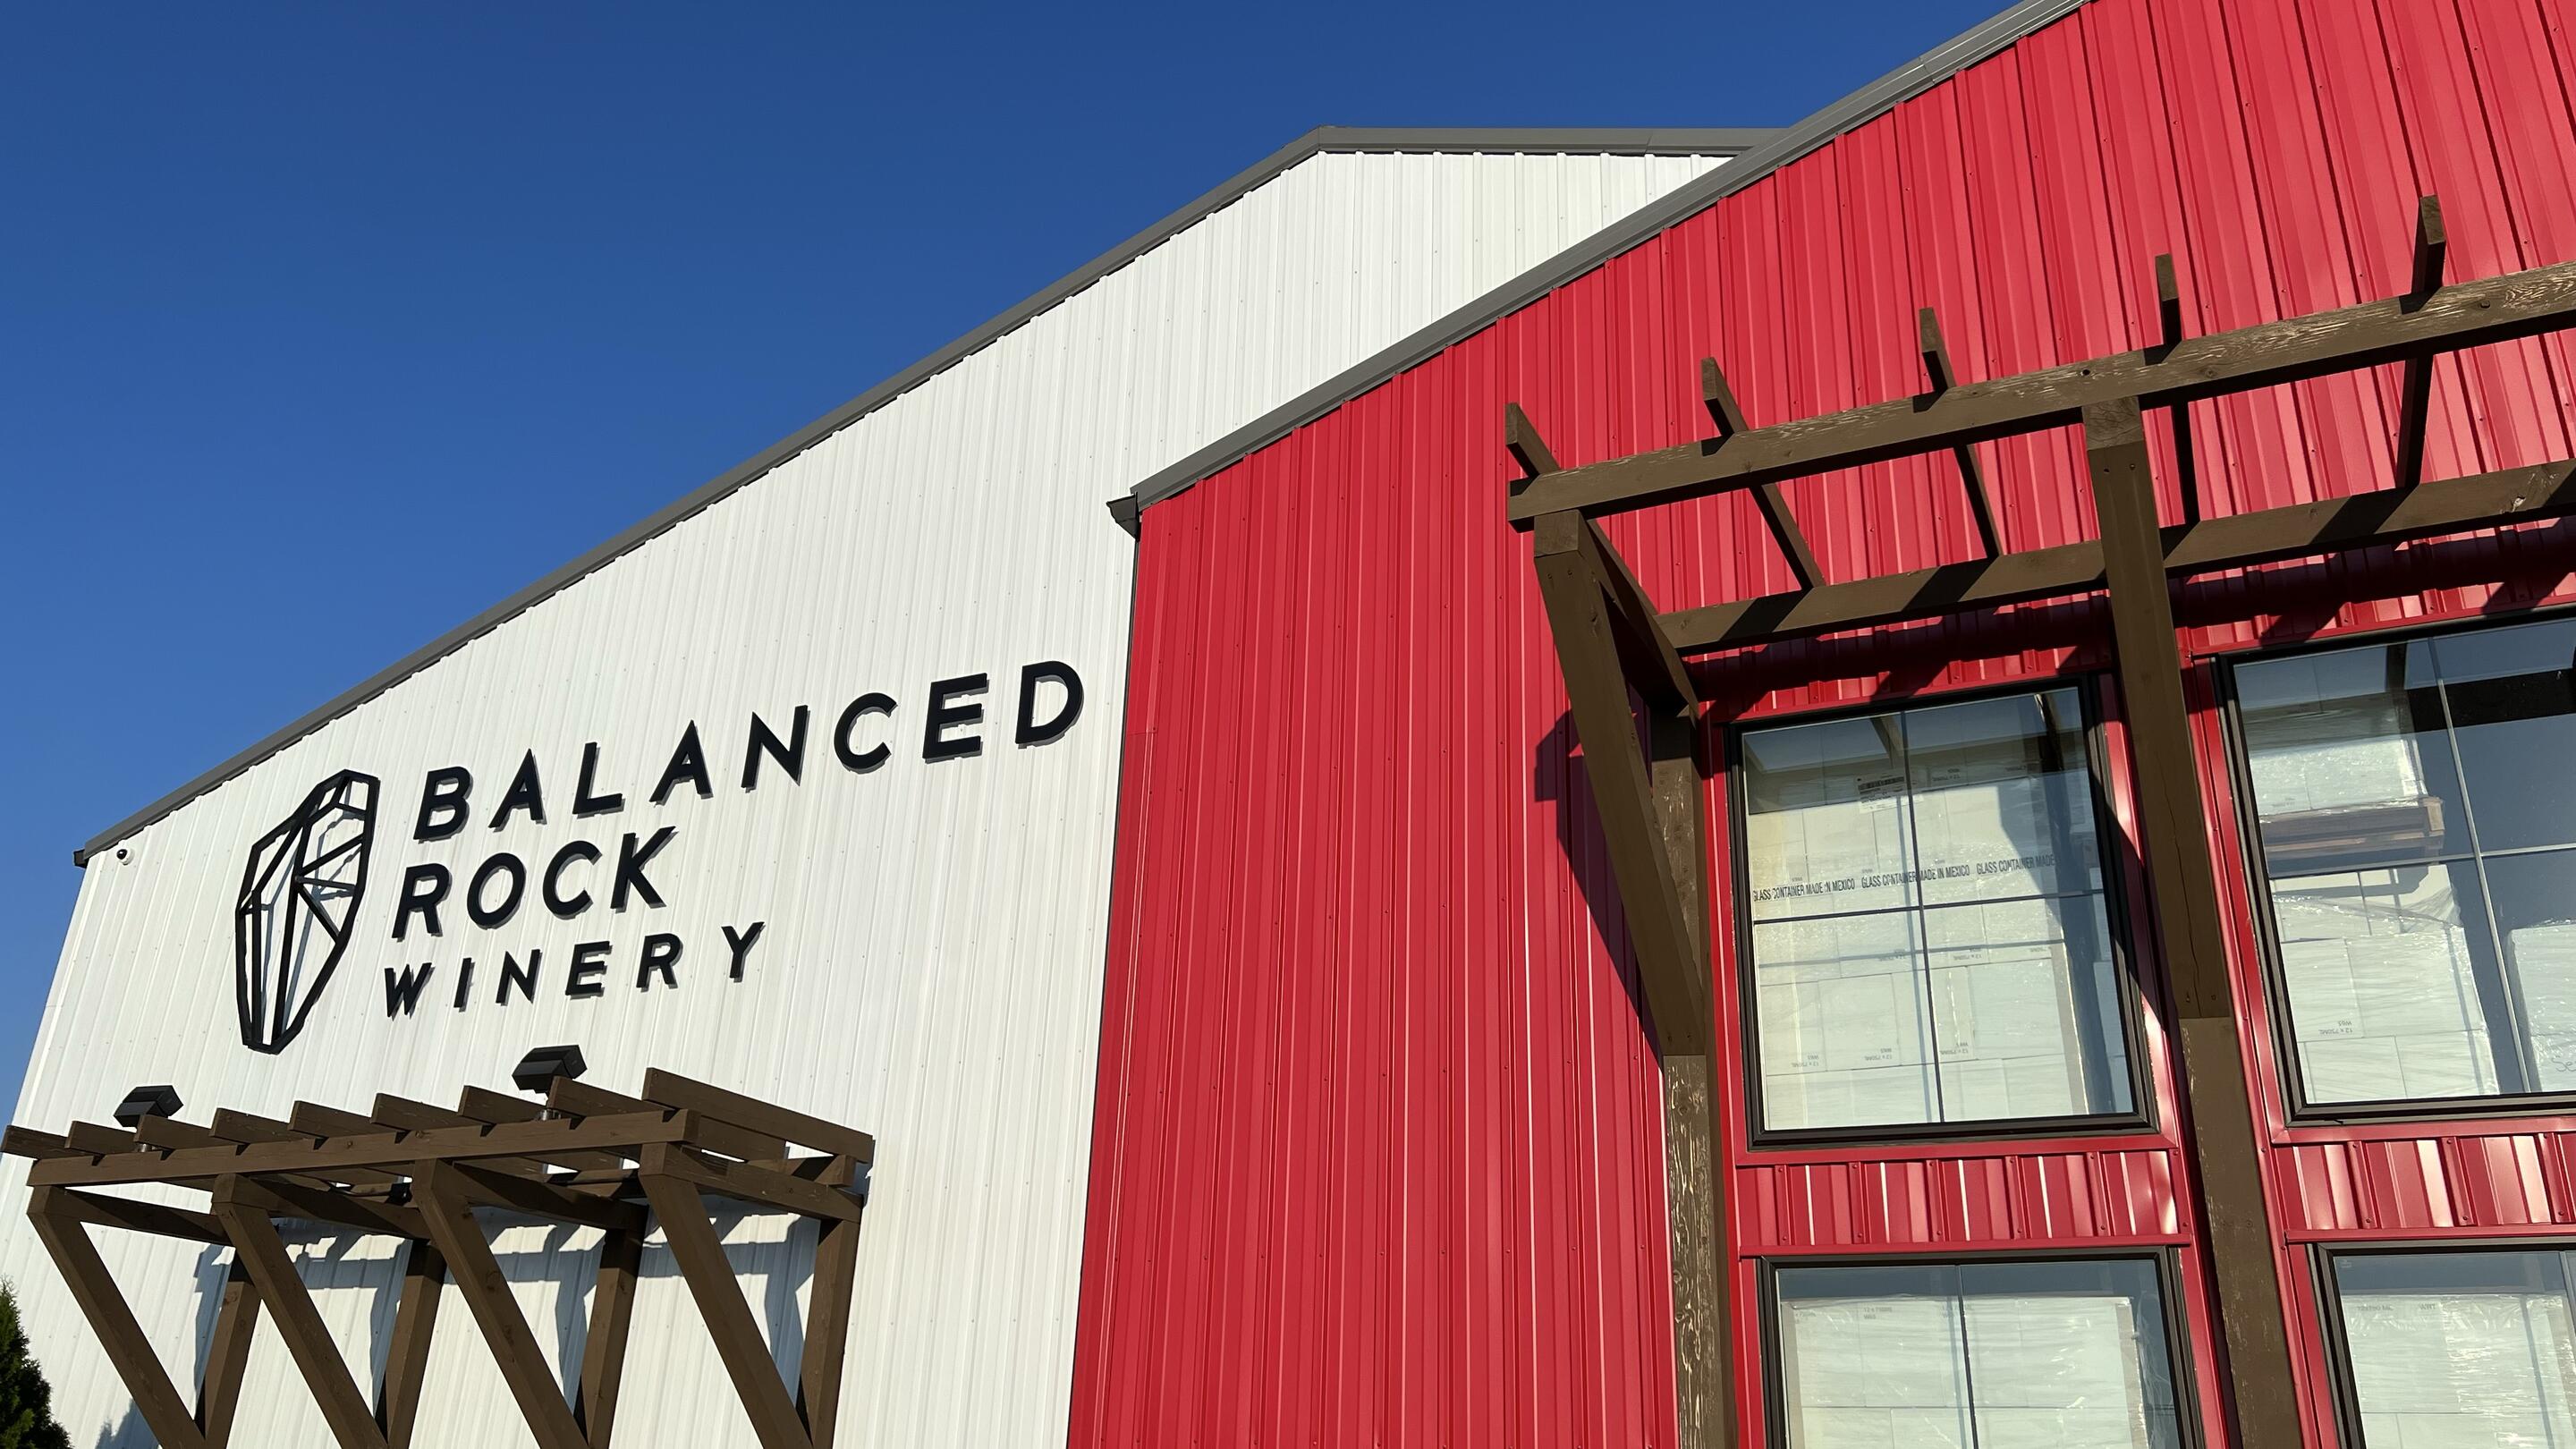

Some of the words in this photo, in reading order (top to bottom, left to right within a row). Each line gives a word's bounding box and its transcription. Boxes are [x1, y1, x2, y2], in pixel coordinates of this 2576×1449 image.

[413, 661, 1085, 845] BALANCED
[392, 826, 679, 944] ROCK
[1752, 889, 1772, 902] GLASS
[1772, 885, 1805, 900] CONTAINER
[1806, 881, 1824, 895] MADE
[1824, 881, 1832, 894] IN
[1833, 877, 1856, 893] MEXICO
[1861, 875, 1882, 889] GLASS
[1882, 870, 1917, 886] CONTAINER
[1918, 869, 1937, 882] MADE
[1936, 868, 1945, 879] IN
[1945, 864, 1970, 877] MEXICO
[1976, 861, 1998, 875] GLASS
[1998, 856, 2035, 872] CONTAINER
[2035, 853, 2055, 868] MADE
[385, 922, 766, 1022] WINERY
